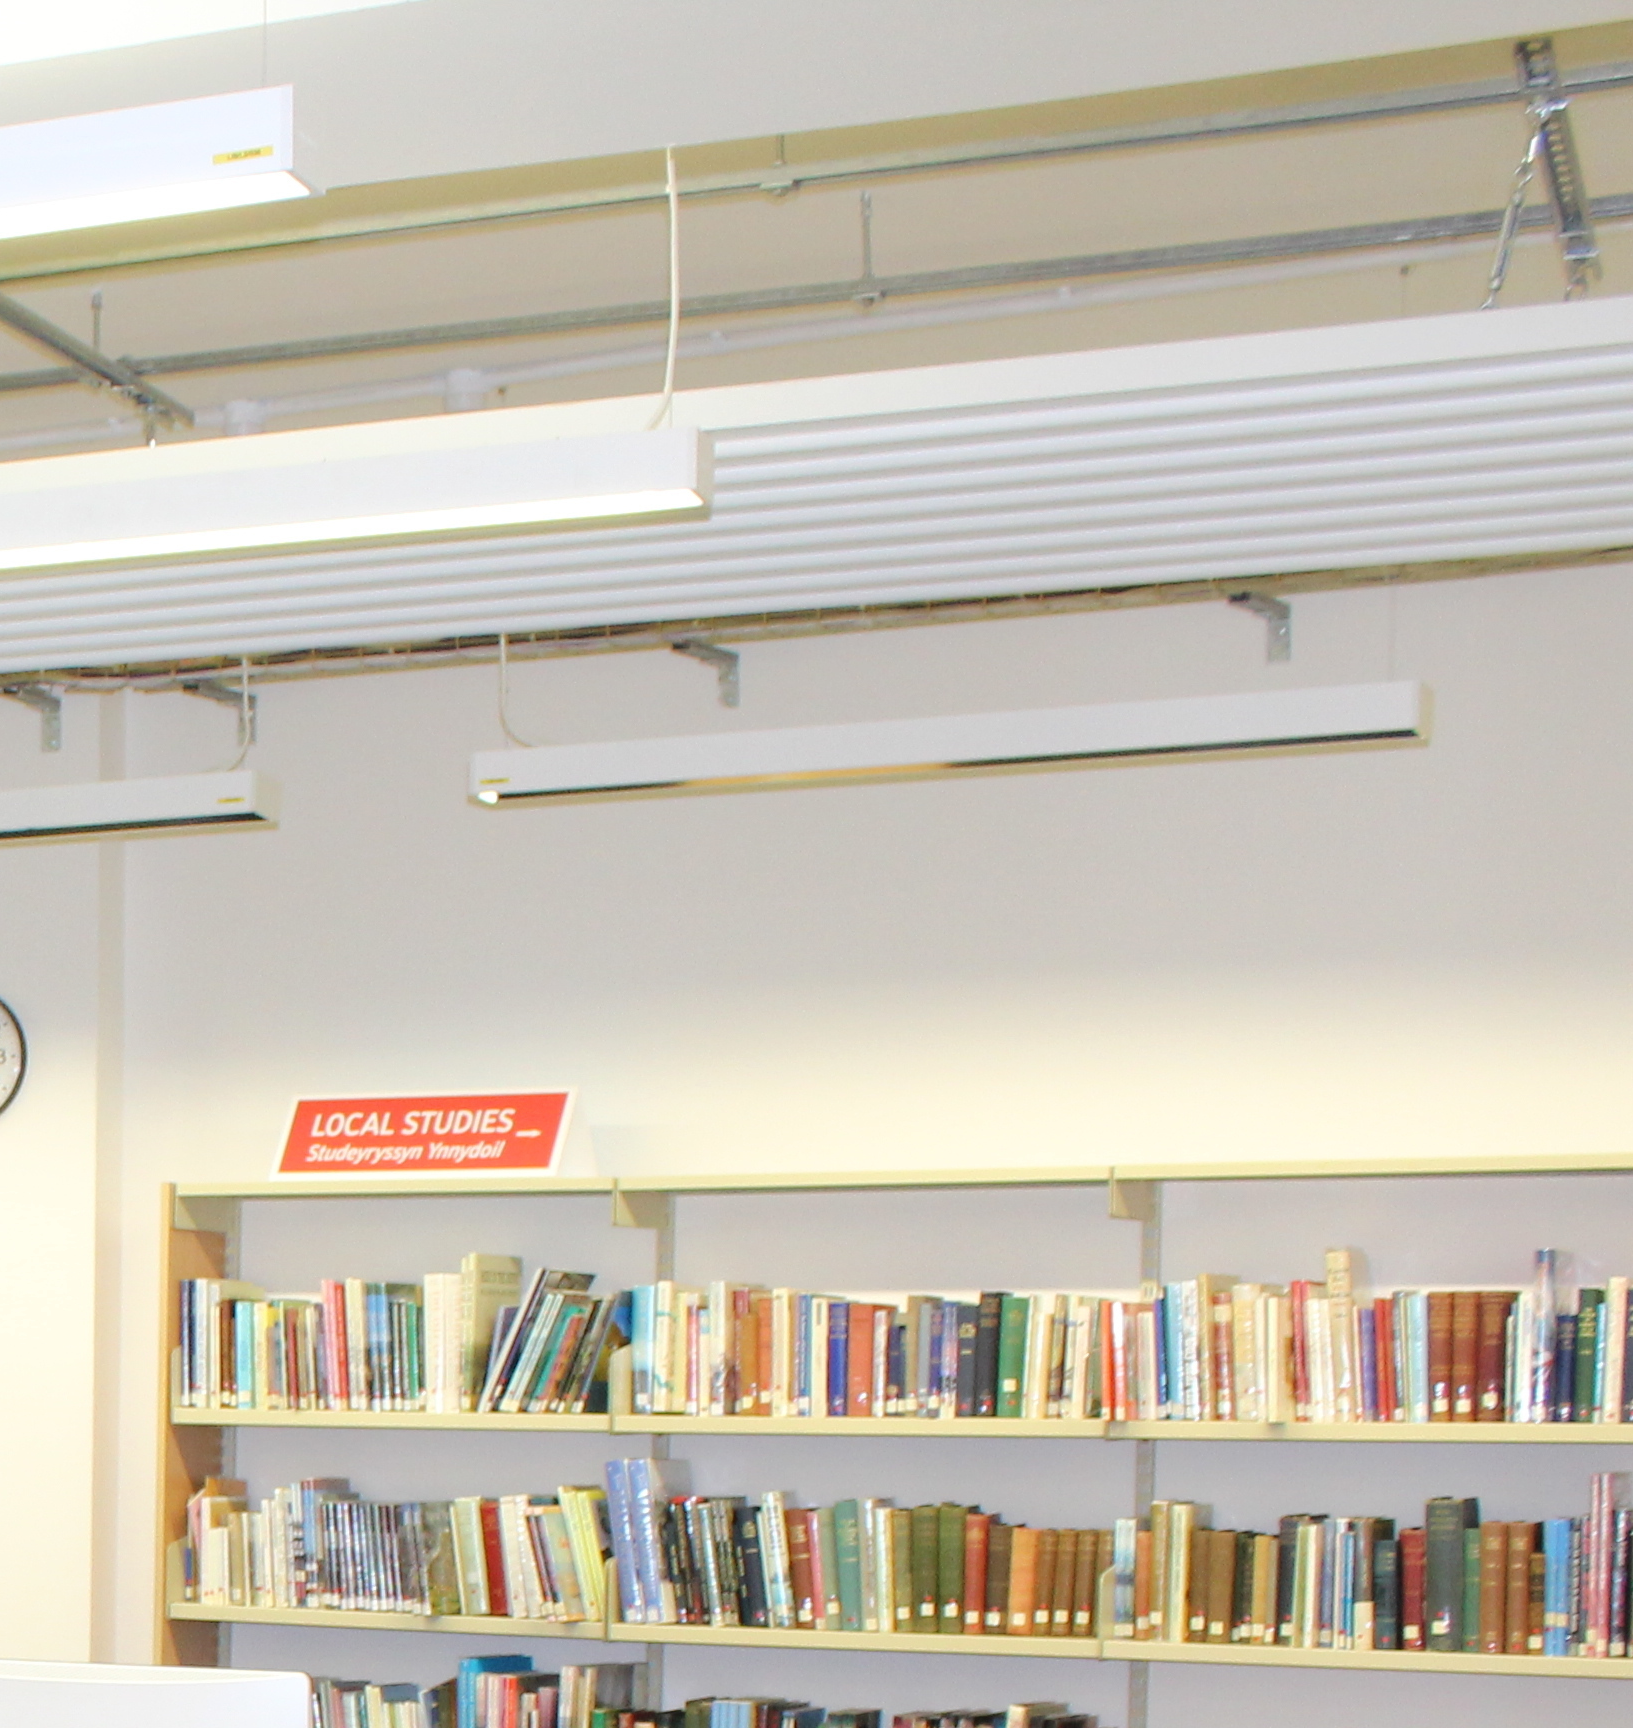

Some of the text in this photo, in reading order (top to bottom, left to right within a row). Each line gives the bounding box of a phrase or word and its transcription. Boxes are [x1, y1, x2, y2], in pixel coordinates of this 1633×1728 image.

[310, 1108, 516, 1137] LOCAL STUDIES
[305, 1140, 506, 1165] Studeyryssyn Ynnydoil
